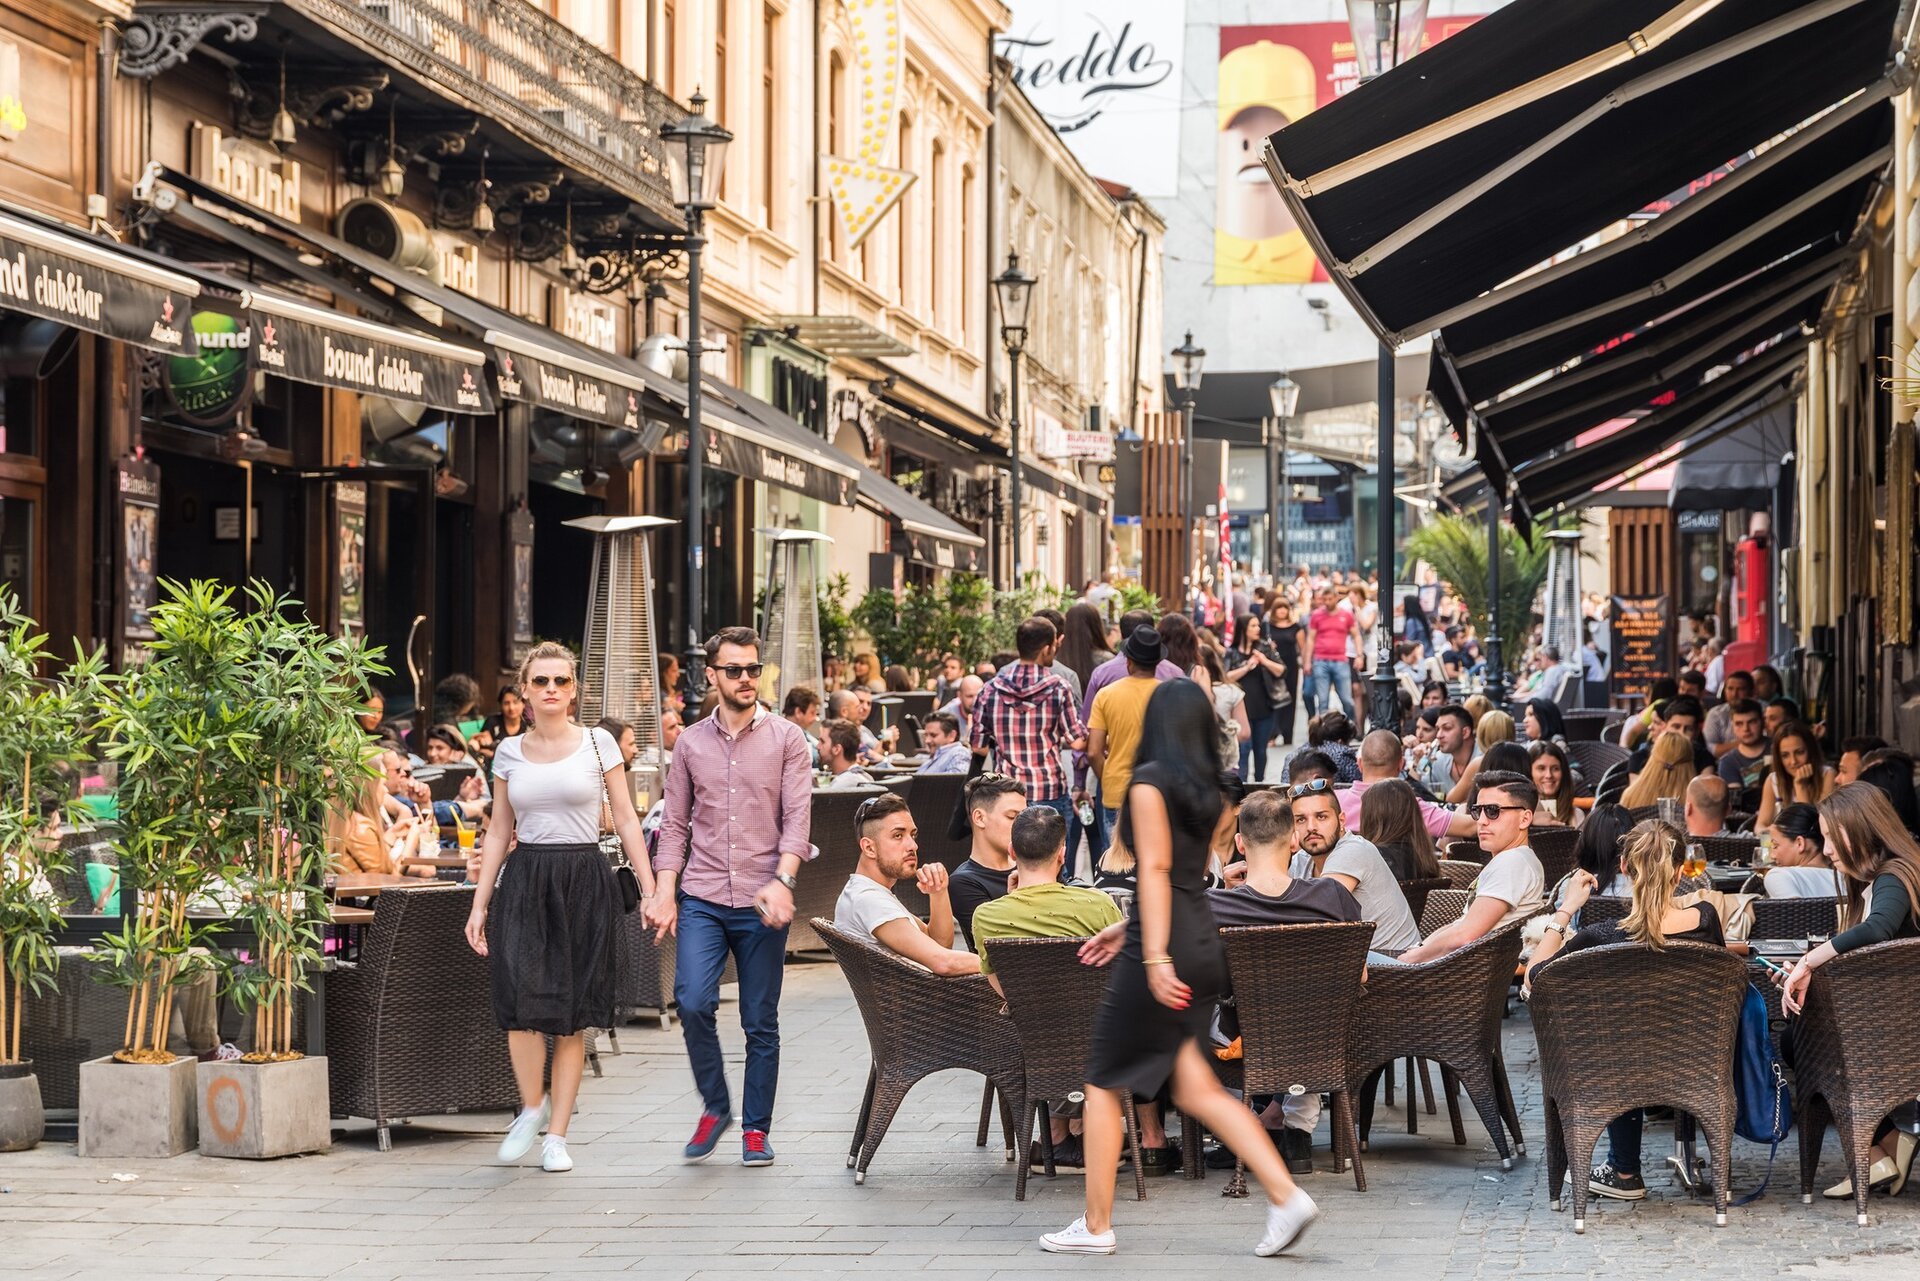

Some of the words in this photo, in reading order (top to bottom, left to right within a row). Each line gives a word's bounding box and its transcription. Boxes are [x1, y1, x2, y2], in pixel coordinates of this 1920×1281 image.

[202, 125, 301, 224] bound
[34, 264, 103, 321] club&bar
[194, 326, 251, 349] und
[323, 336, 375, 386] bound
[539, 365, 576, 407] bound
